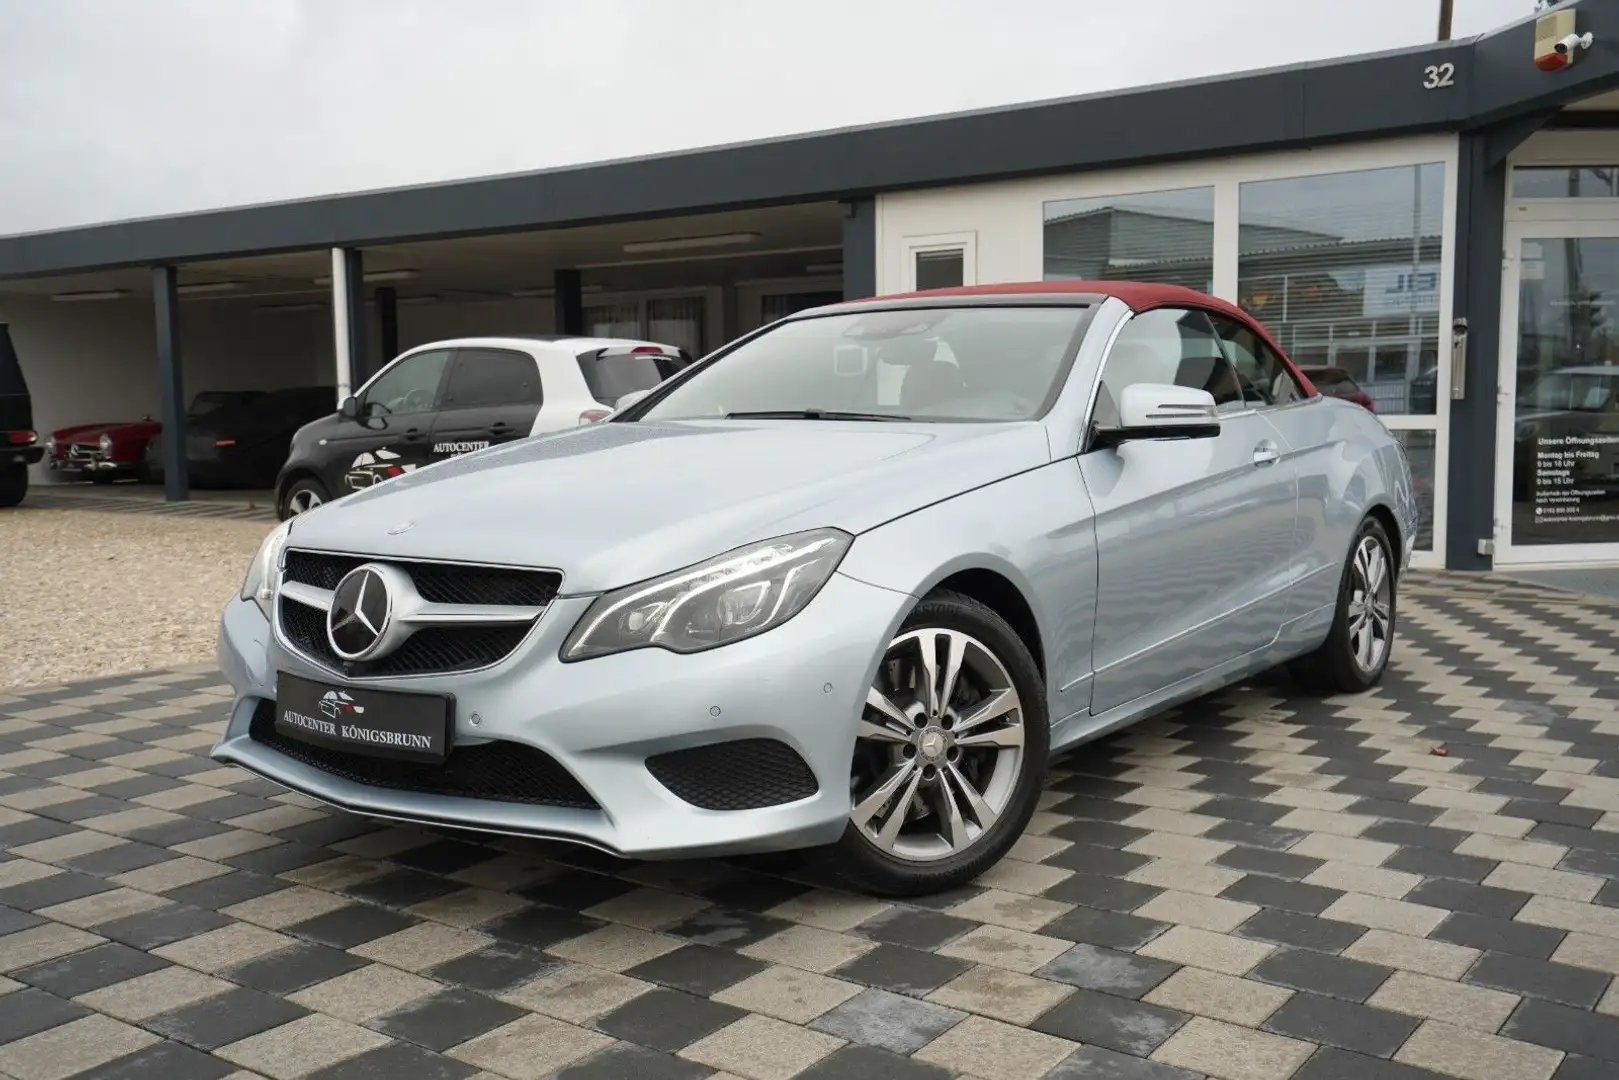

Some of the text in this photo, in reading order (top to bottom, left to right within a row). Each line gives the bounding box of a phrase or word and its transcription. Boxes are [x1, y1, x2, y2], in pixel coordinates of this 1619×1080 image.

[1423, 62, 1455, 90] 32
[434, 441, 490, 453] AUTOCENTER
[1576, 451, 1599, 459] Freitag
[283, 709, 432, 749] AUTOCENTER KÖNIGSBRUNN
